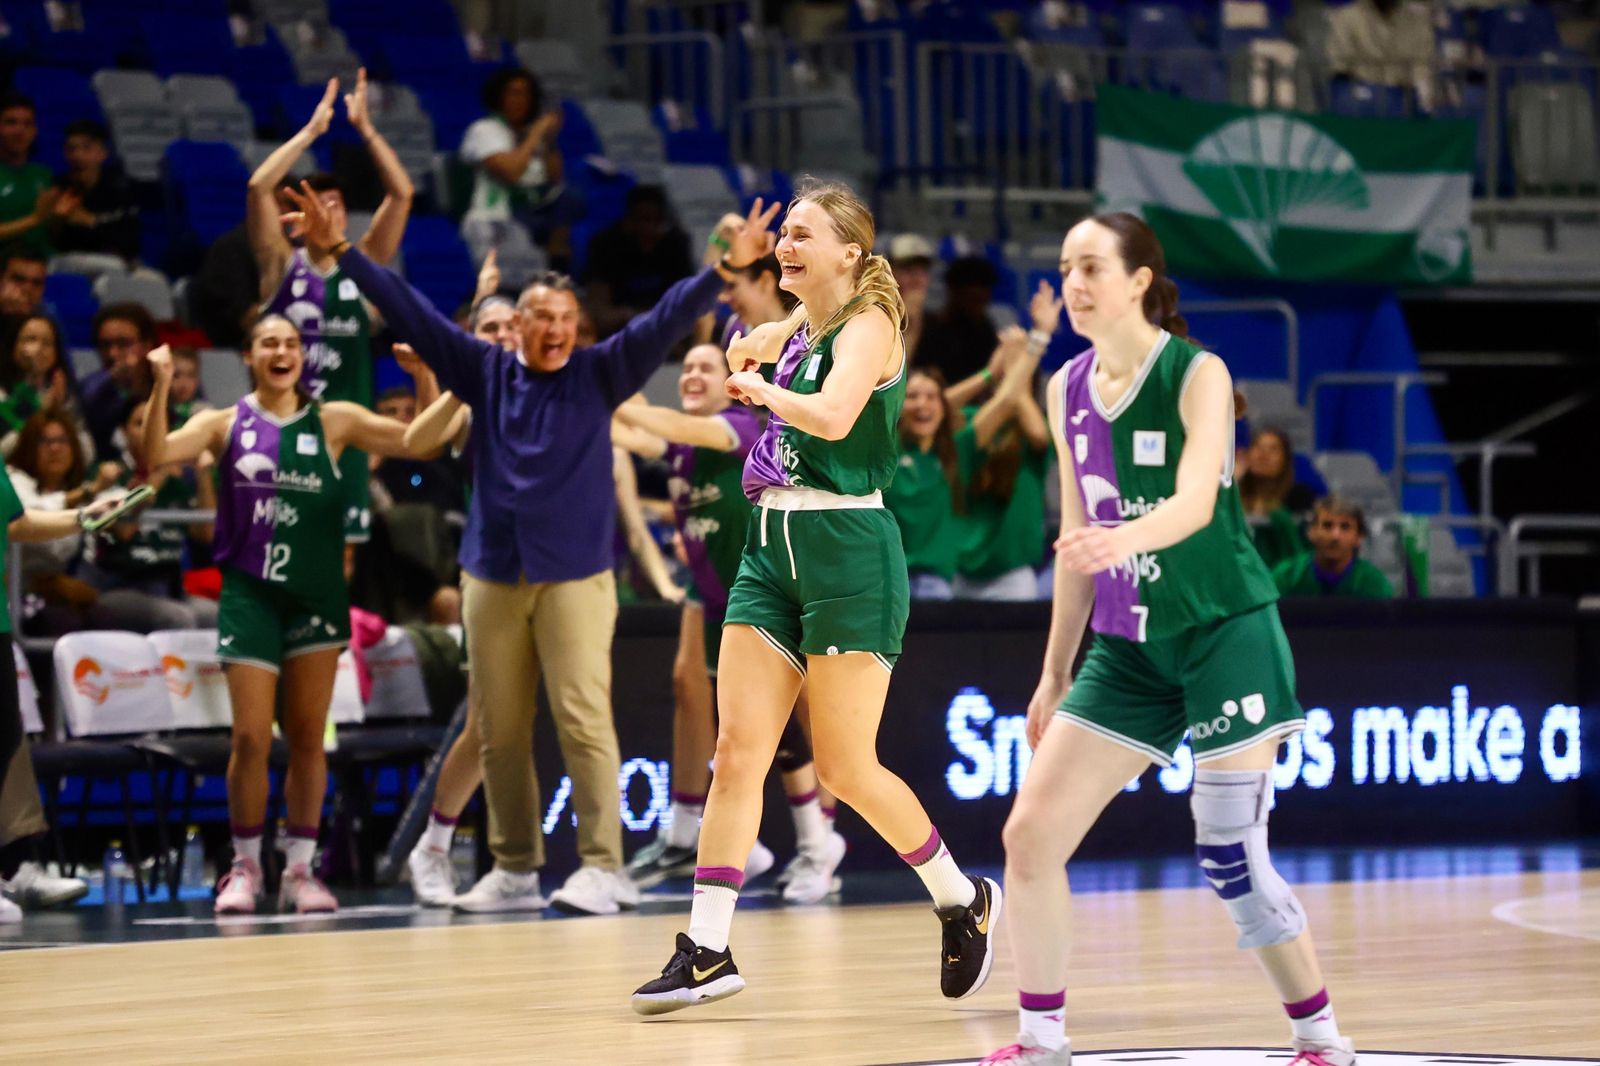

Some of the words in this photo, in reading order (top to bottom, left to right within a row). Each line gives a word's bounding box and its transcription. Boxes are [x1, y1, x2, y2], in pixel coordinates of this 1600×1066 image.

[261, 542, 291, 582] 12
[1129, 605, 1149, 643] 7
[1351, 684, 1525, 786] make
[1539, 703, 1582, 783] a
